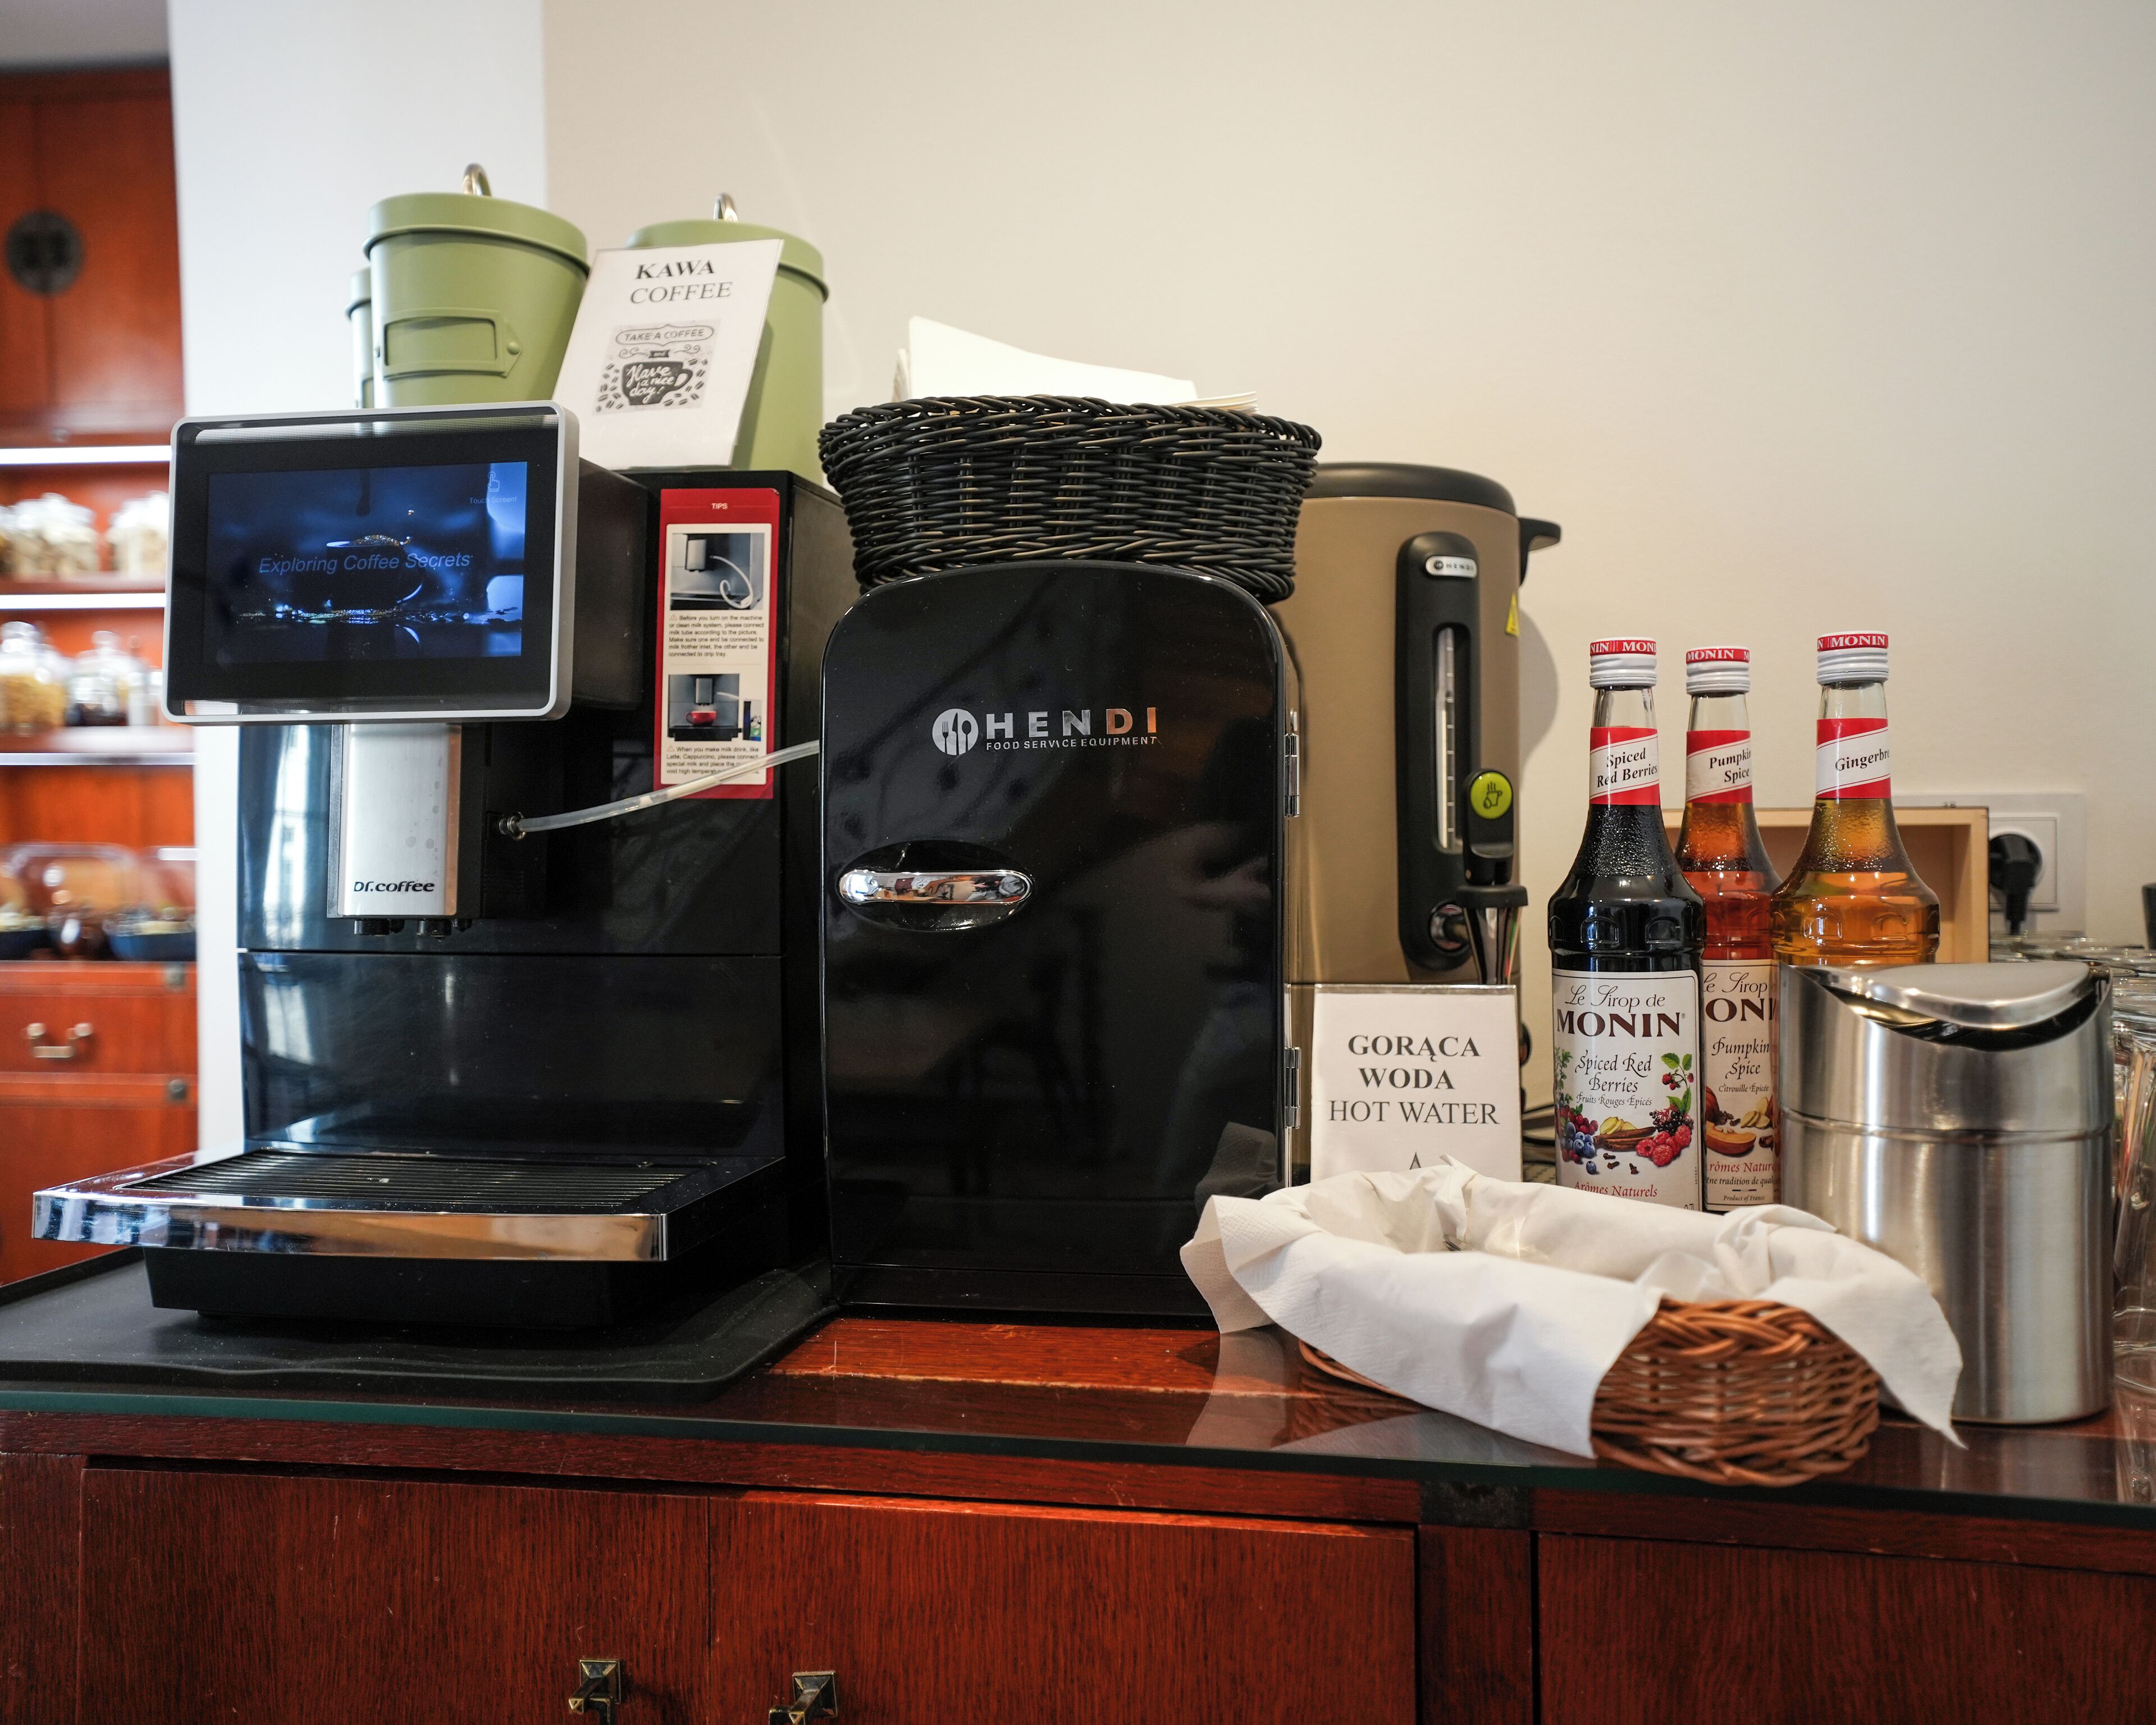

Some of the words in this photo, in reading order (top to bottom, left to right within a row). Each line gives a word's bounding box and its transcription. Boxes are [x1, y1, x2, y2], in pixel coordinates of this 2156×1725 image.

[635, 260, 714, 279] KAWA
[630, 282, 732, 304] COFFEE
[625, 333, 651, 341] TAKE
[664, 329, 704, 339] COFFEE
[626, 364, 672, 387] Have
[650, 376, 674, 385] nice
[629, 381, 665, 404] day!
[259, 557, 337, 575] Exploring
[344, 555, 399, 569] Coffee
[405, 553, 471, 568] Secrets
[1831, 636, 1885, 647] MONIN
[1687, 650, 1734, 661] MONIN
[986, 708, 1157, 740] HENDI
[986, 741, 1020, 750] FOOD
[1024, 739, 1076, 749] SERVICE
[1081, 737, 1157, 747] EQUIPMENT
[1607, 747, 1645, 769] Spiced
[1597, 771, 1617, 788] Red
[1622, 764, 1657, 781] Berries
[1724, 768, 1749, 783] Spice
[353, 881, 435, 892] Dr.coffee
[1722, 972, 1767, 997] Sirop
[1565, 985, 1586, 1006] Le
[1591, 985, 1640, 1013] Sirop
[1646, 994, 1665, 1007] de
[1348, 1035, 1481, 1062] GORĄCA
[1711, 1037, 1769, 1058] Pumpkin
[1575, 1049, 1618, 1075] Spiced
[1623, 1053, 1652, 1078] Red
[1725, 1057, 1760, 1080] Spice
[1359, 1068, 1455, 1089] WODA
[1589, 1073, 1638, 1092] Berries
[1719, 1083, 1748, 1092] Citrouille
[1577, 1092, 1596, 1103] Fruits
[1598, 1094, 1625, 1108] Rouges
[1329, 1101, 1390, 1122] HOT
[1397, 1102, 1500, 1124] WATER
[1575, 1181, 1608, 1195] Arômes
[1612, 1185, 1657, 1197] Naturels
